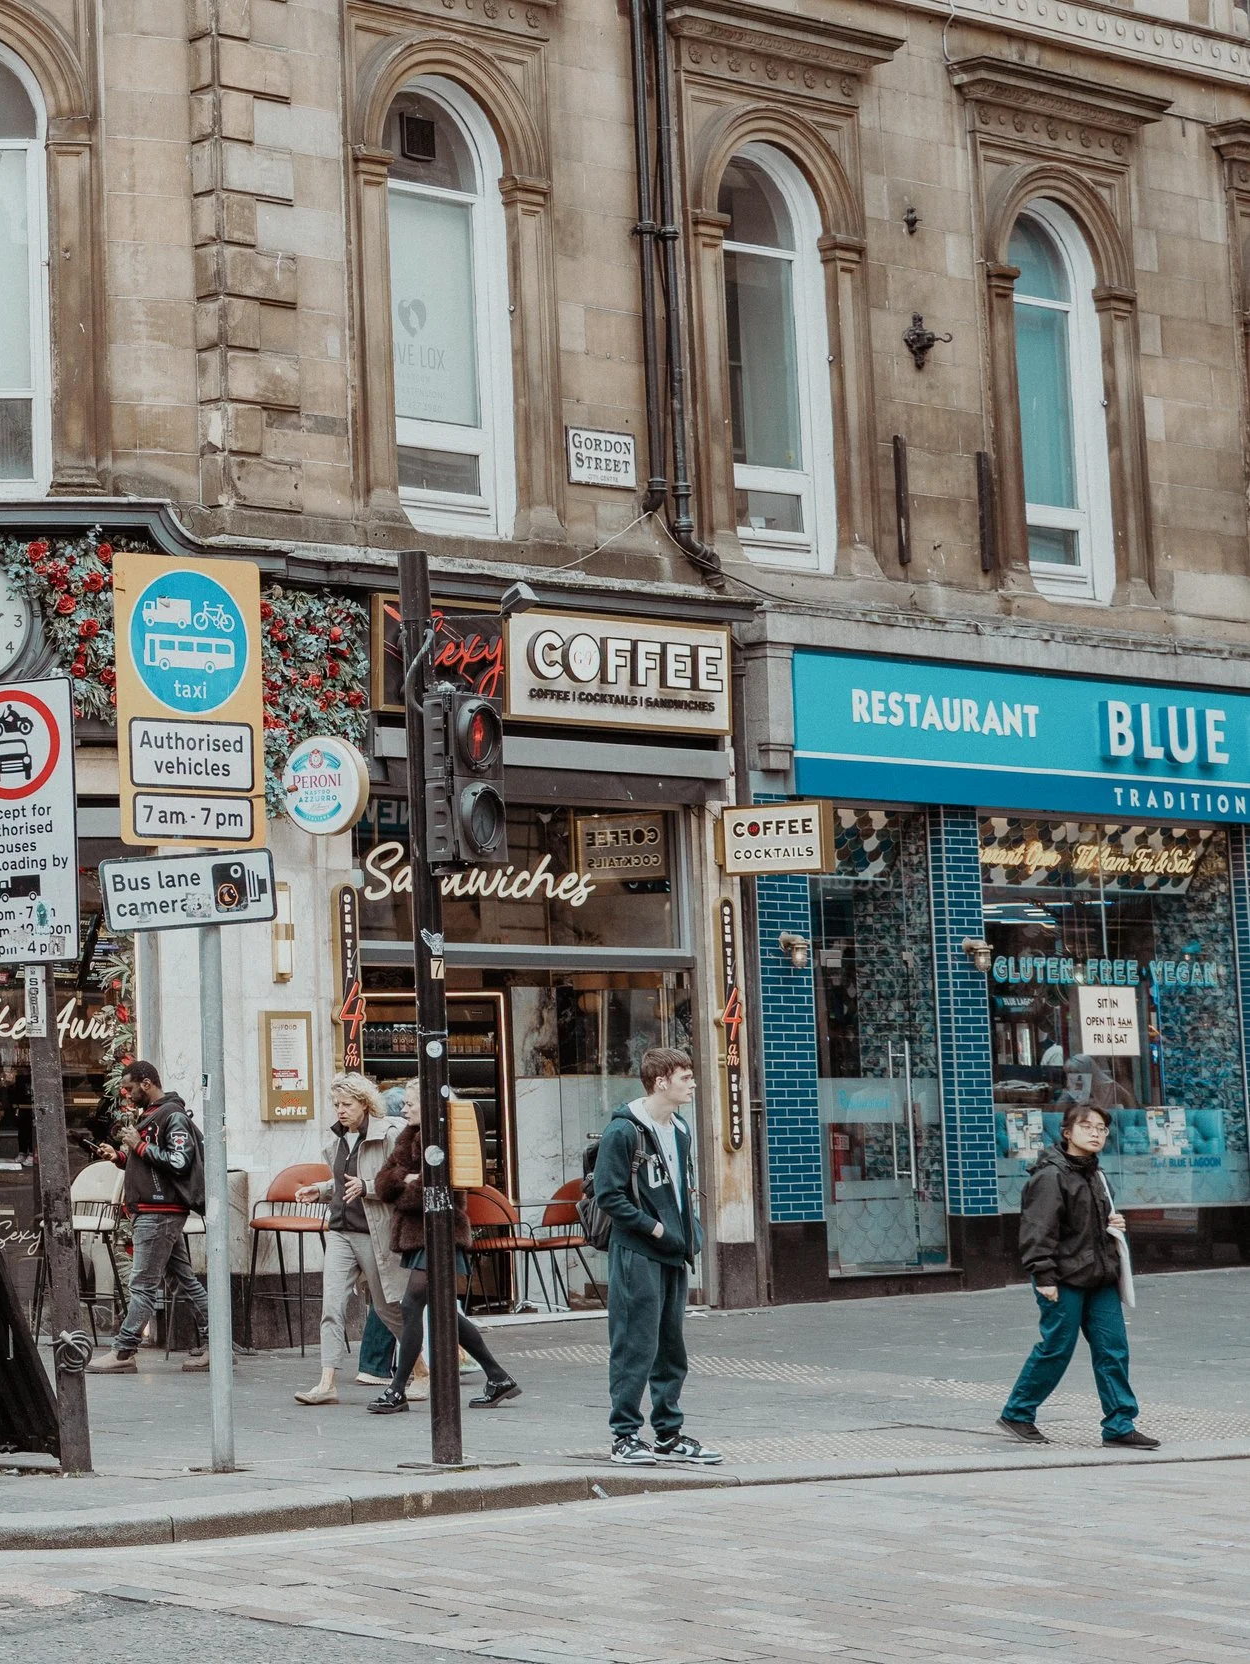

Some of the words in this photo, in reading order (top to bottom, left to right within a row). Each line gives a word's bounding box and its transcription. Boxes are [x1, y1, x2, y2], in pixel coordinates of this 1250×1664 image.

[419, 345, 446, 371] LOX
[572, 432, 631, 455] GORDON
[574, 451, 631, 474] STREET
[13, 614, 23, 628] 3
[5, 641, 15, 654] 4
[527, 629, 724, 693] COFFEE
[174, 679, 208, 699] taxi
[528, 688, 570, 701] COFFEE
[578, 691, 638, 706] COCKTAILS
[644, 696, 716, 712] SANDWICHES
[851, 688, 1039, 738] RESTAURANT
[139, 729, 244, 753] Authorised
[1102, 700, 1230, 765] BLUE
[153, 755, 231, 777] vehicles
[292, 773, 342, 789] PERONI
[31, 803, 52, 817] for
[298, 794, 338, 803] AZZURRO
[1113, 787, 1247, 815] TRADITION
[732, 817, 813, 838] COFFEE
[52, 854, 69, 869] by
[733, 846, 814, 860] COCKTAILS
[112, 873, 153, 894] Bus
[158, 868, 201, 890] lane
[343, 893, 353, 933] OPEN
[722, 906, 732, 943] OPEN
[345, 939, 354, 978] TILL
[433, 959, 442, 976] 7
[725, 948, 734, 985] TILL
[992, 955, 1075, 984] GLUTEN
[1086, 958, 1140, 985] FREE
[1149, 960, 1218, 987] VEGAN
[339, 980, 364, 1040] 4
[722, 986, 742, 1041] 4
[1097, 998, 1109, 1009] SIT
[1110, 998, 1119, 1009] IN
[1086, 1016, 1105, 1026] OPEN
[1106, 1016, 1116, 1027] TIL
[1117, 1017, 1133, 1027] 4AM
[1093, 1033, 1105, 1044] FRI
[1106, 1033, 1113, 1044] &
[1114, 1033, 1128, 1044] SAT
[344, 1043, 360, 1067] am
[726, 1043, 740, 1066] am
[732, 1115, 740, 1143] SAT
[1169, 1158, 1187, 1168] BLUE
[1188, 1157, 1222, 1168] LAGOON
